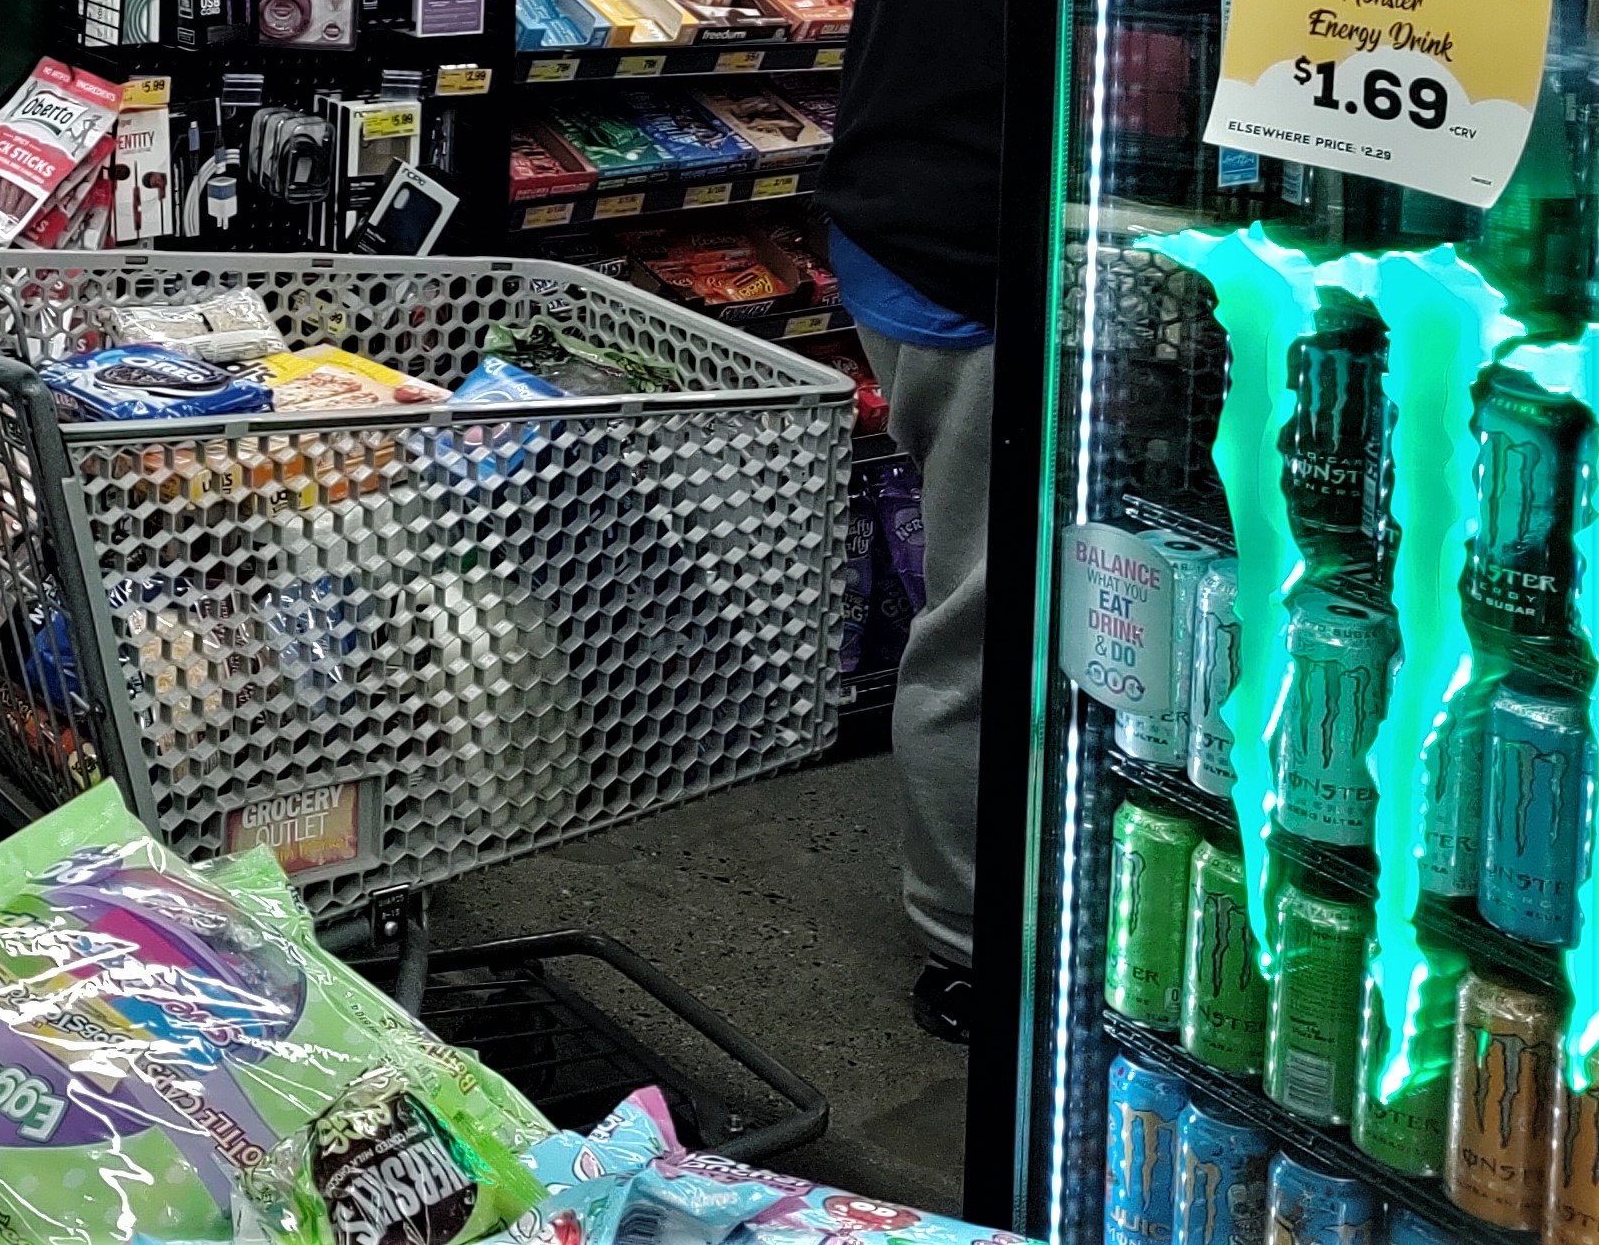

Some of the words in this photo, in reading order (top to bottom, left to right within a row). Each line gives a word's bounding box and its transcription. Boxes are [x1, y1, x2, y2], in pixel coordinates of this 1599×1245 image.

[201, 6, 220, 16] CORD
[1309, 10, 1381, 52] Energy
[1389, 21, 1455, 62] Drink
[142, 80, 165, 92] $5.99
[1293, 55, 1449, 130] $1.69
[21, 98, 75, 125] Oberto
[1228, 120, 1311, 146] ELSEWHERE
[1315, 137, 1357, 155] PRICE:
[1361, 146, 1392, 161] $2.29
[10, 147, 55, 177] STICKS
[122, 356, 205, 383] OREO
[1295, 448, 1363, 466] LO-CAR
[1075, 540, 1161, 590] BALANCE
[1087, 569, 1121, 593] WHAT
[1124, 580, 1148, 603] YOU
[1100, 589, 1133, 618] EAT
[1089, 610, 1145, 648] DRINK
[1095, 635, 1108, 657] &
[1111, 642, 1136, 667] DO
[242, 784, 344, 829] GROCERY
[256, 812, 328, 847] OUTLET
[207, 1098, 264, 1168] OTTLE
